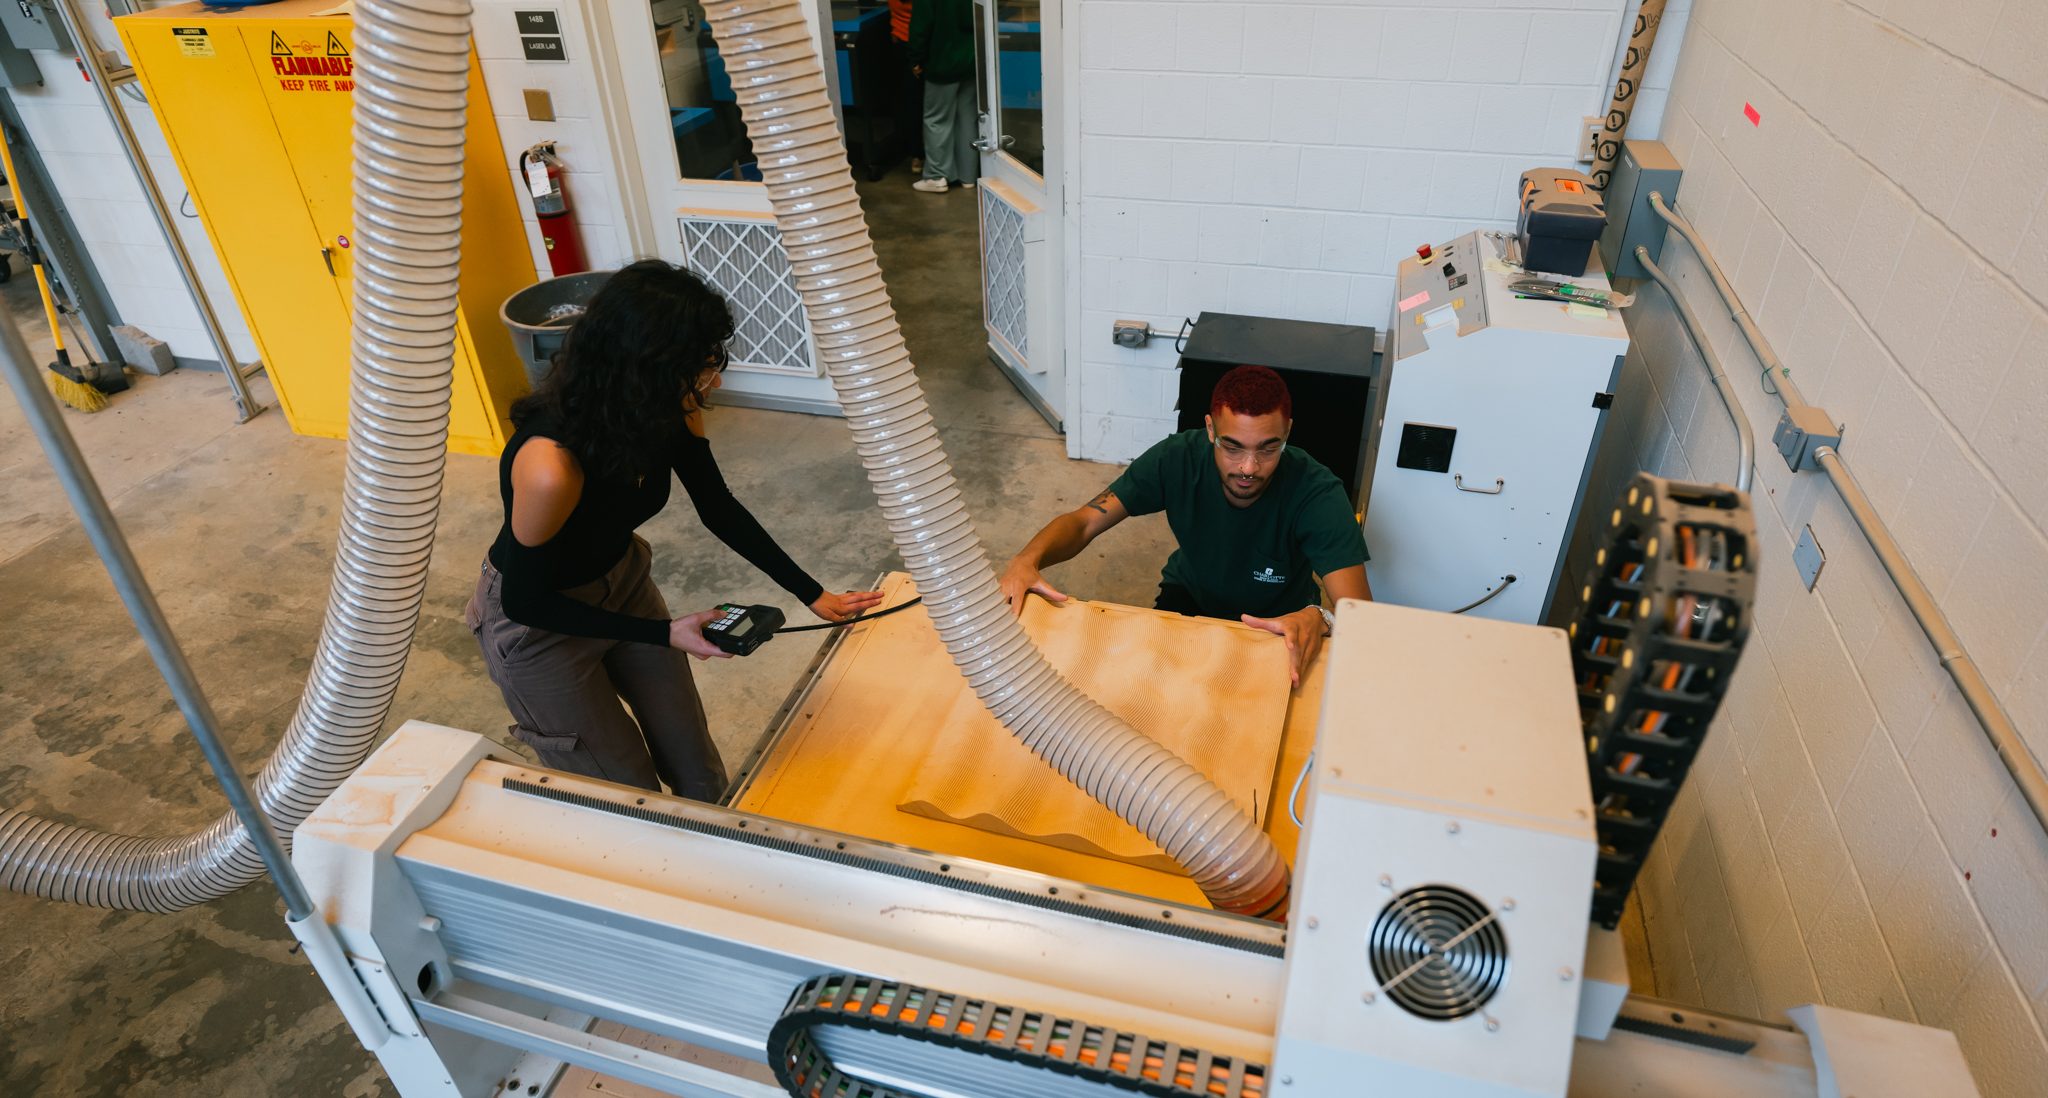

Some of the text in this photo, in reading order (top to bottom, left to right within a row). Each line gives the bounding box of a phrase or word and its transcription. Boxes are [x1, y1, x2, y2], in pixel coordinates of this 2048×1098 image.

[280, 79, 356, 92] KEEP FIRE AWA
